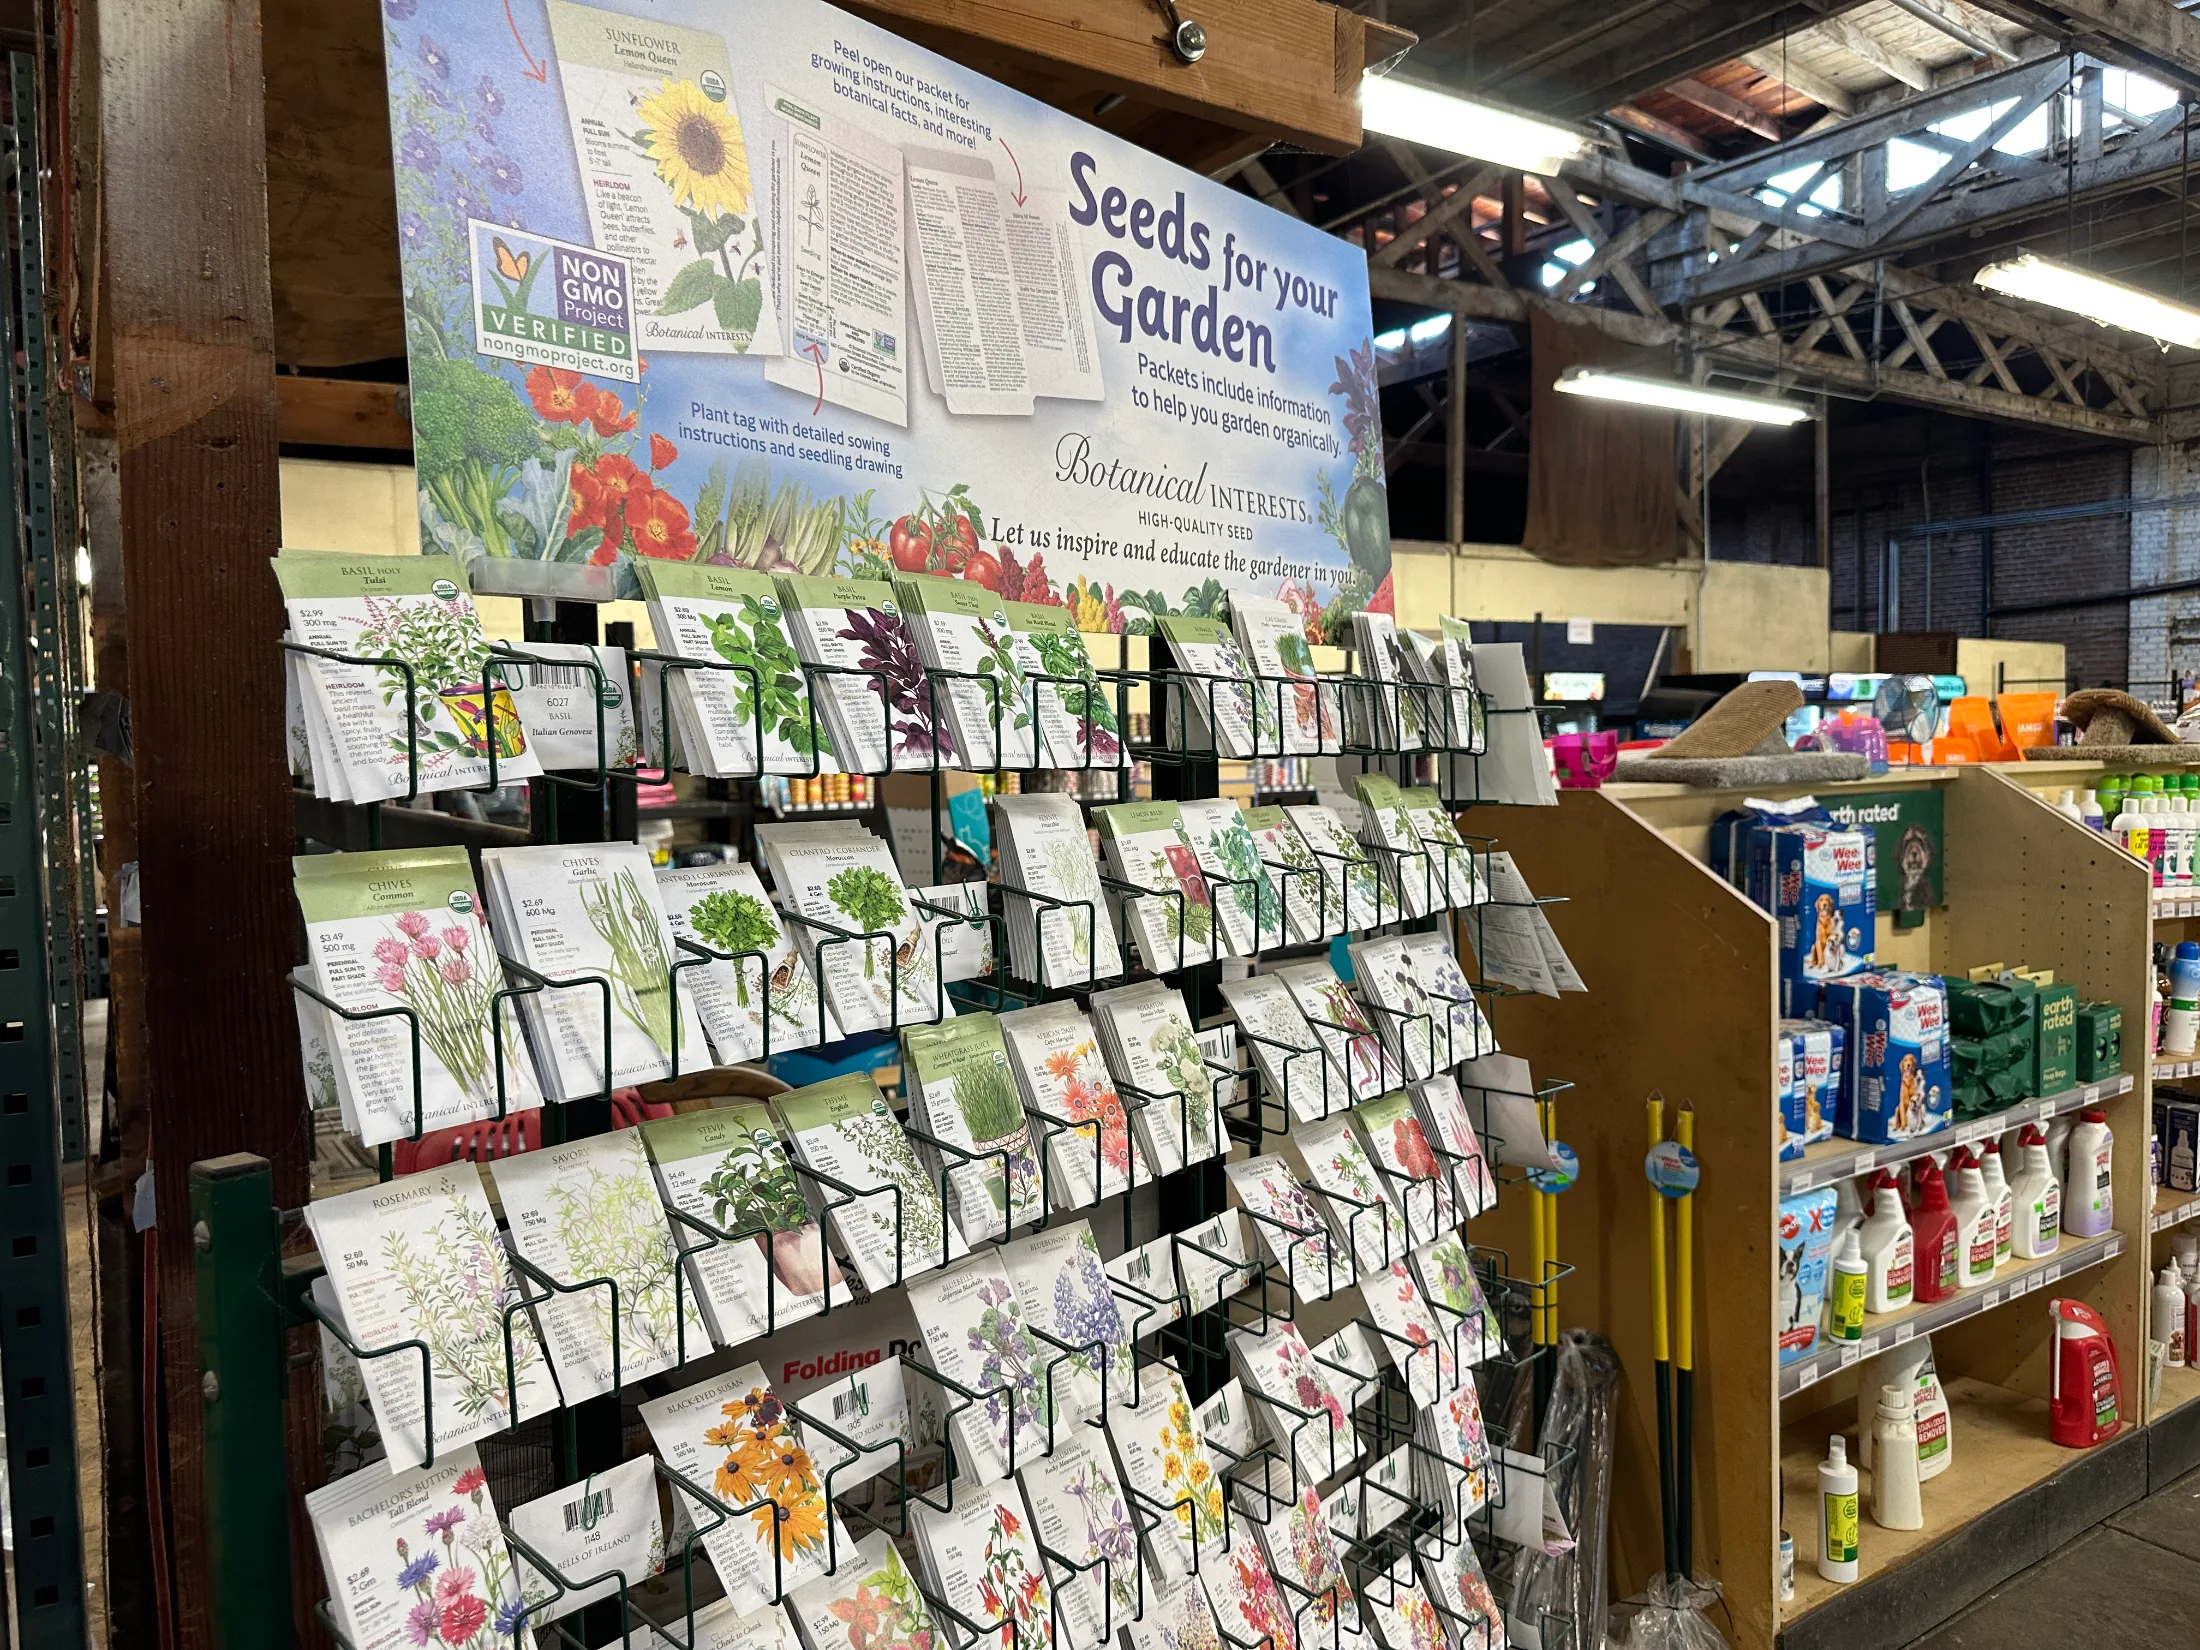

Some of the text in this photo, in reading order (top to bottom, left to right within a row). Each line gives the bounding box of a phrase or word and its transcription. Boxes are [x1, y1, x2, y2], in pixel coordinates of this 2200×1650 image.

[606, 28, 680, 54] SUNFLOWER
[614, 44, 677, 66] Lemon Queen
[834, 40, 969, 111] Peel open our packet for
[811, 53, 992, 141] growing instructions, interesting
[833, 78, 977, 149] botanical facts, and more!
[794, 140, 826, 159] SUNFLOWER
[801, 152, 821, 166] Lemon
[801, 162, 820, 178] Queen
[593, 179, 630, 190] HEIRLOOM
[596, 189, 642, 202] Like beacon
[626, 214, 650, 224] attracts
[605, 233, 636, 242] and other
[1069, 151, 1337, 318] Seeds for your
[607, 244, 641, 254] pollinators
[801, 245, 821, 261] Seedling
[562, 255, 620, 287] NON
[562, 280, 622, 309] GMO
[564, 301, 624, 328] Project
[1092, 251, 1276, 373] Garden
[491, 310, 625, 354] VERIFIED
[646, 322, 705, 339] Botanical
[484, 337, 633, 379] nongmoproject.org
[1138, 352, 1331, 425] Packets include information
[691, 402, 890, 457] Plant tag with detailed sowing
[1132, 385, 1341, 459] to help you garden organically.
[679, 423, 903, 479] instructions and seedling drawing
[1055, 432, 1208, 505] Botanical
[1138, 511, 1253, 541] HIGH-QUALITY SEED
[991, 517, 1355, 588] Let us inspire and educate the gardener in you.
[342, 567, 375, 576] BASIL
[363, 577, 386, 585] Tulsi
[707, 575, 731, 584] BASIL
[711, 584, 733, 592] Lemon
[300, 610, 323, 618] $2.99
[303, 619, 321, 627] 300
[326, 682, 365, 690] HEIRLOOM
[547, 698, 569, 706] 6027
[1858, 803, 1898, 823] rated
[790, 846, 882, 857] CILANTRO CORIANDER
[1833, 848, 1858, 859] Wee
[563, 857, 600, 868] CHIVES
[1837, 859, 1862, 871] Wee
[572, 867, 597, 876] Garlic
[697, 869, 746, 880] CORIANDER
[368, 879, 412, 891] CHIVES
[686, 880, 717, 888] Moroccan
[373, 890, 414, 902] Common
[522, 899, 543, 908] $2.69
[542, 907, 556, 916] Mg
[320, 933, 344, 943] $3.49
[323, 943, 355, 952] 500 mg
[327, 958, 359, 967] PERENNIAL
[329, 967, 344, 975] FULL
[347, 972, 366, 980] SHADE
[1917, 1002, 1938, 1018] Wee
[2043, 995, 2073, 1016] earth
[345, 1018, 390, 1032] edible flowers
[1920, 1013, 1941, 1029] Wee
[2043, 1010, 2074, 1031] rated
[932, 1040, 990, 1062] WHEATGRASS JUICE
[823, 1093, 848, 1106] THYME
[830, 1102, 850, 1112] English
[697, 1123, 727, 1136] STEVIA
[704, 1132, 726, 1143] Candy
[552, 1148, 590, 1164] SAVORY
[558, 1160, 590, 1173] Summer
[668, 1170, 686, 1181] $4.49
[372, 1185, 432, 1210] ROSEMARY
[521, 1210, 538, 1220] $2.69
[524, 1219, 537, 1227] 750
[1030, 1233, 1070, 1251] BLUEBONNET
[343, 1250, 364, 1261] $2.69
[346, 1259, 368, 1270] 50 Mg
[942, 1273, 974, 1292] BLUEBELLS
[361, 1323, 399, 1341] HEIRLOOM
[927, 1325, 940, 1337] $2.99
[667, 1378, 744, 1415] BLACK-EYED SUSAN
[847, 1419, 861, 1431] 1305
[1918, 1425, 1946, 1443] REMOVER
[1048, 1442, 1083, 1464] COLUMBINE
[348, 1464, 459, 1528] BACHELOR'S BUTTON
[953, 1489, 992, 1515] COLUMBINE
[388, 1492, 430, 1519] Tall Blend
[961, 1505, 980, 1520] Eastern
[584, 1531, 601, 1545] 1148
[557, 1533, 631, 1570] BELLS OF IRELAND
[347, 1566, 370, 1585] $2.69
[359, 1577, 377, 1592] Gm
[813, 1615, 829, 1630] $2.99
[365, 1627, 401, 1650] HEIRLOOM
